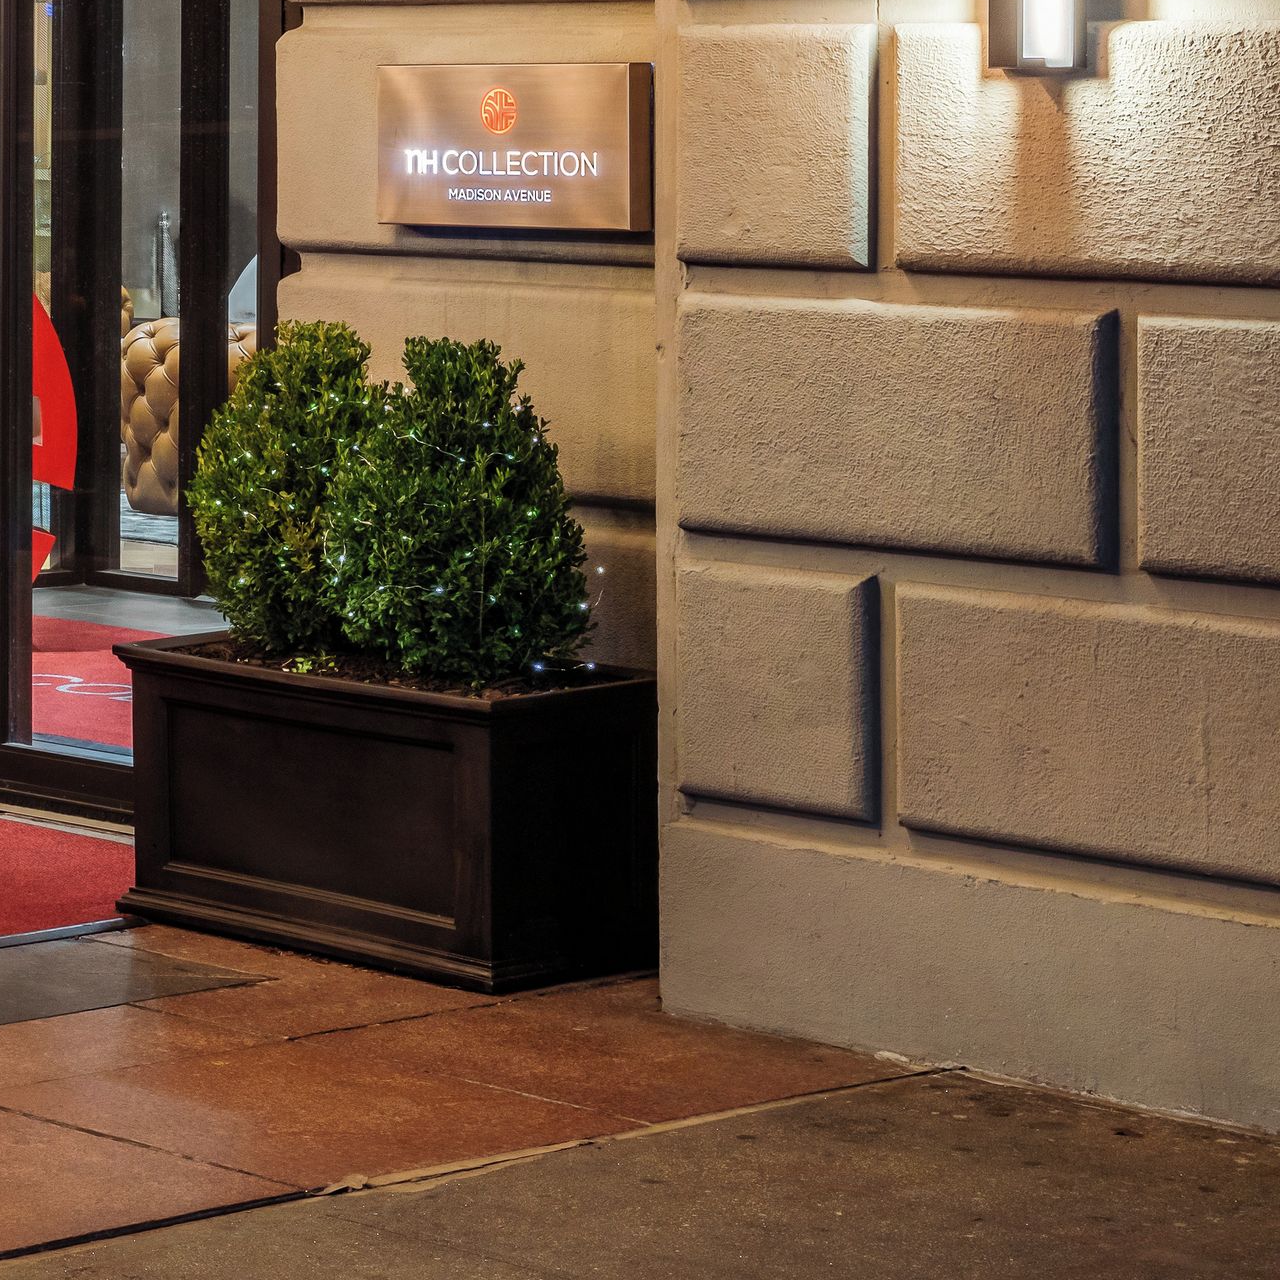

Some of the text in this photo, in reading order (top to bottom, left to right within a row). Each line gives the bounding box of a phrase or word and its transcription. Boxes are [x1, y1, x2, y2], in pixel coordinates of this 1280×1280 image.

[441, 150, 598, 177] COLLECTION
[448, 187, 552, 203] MADISON AVENUE
